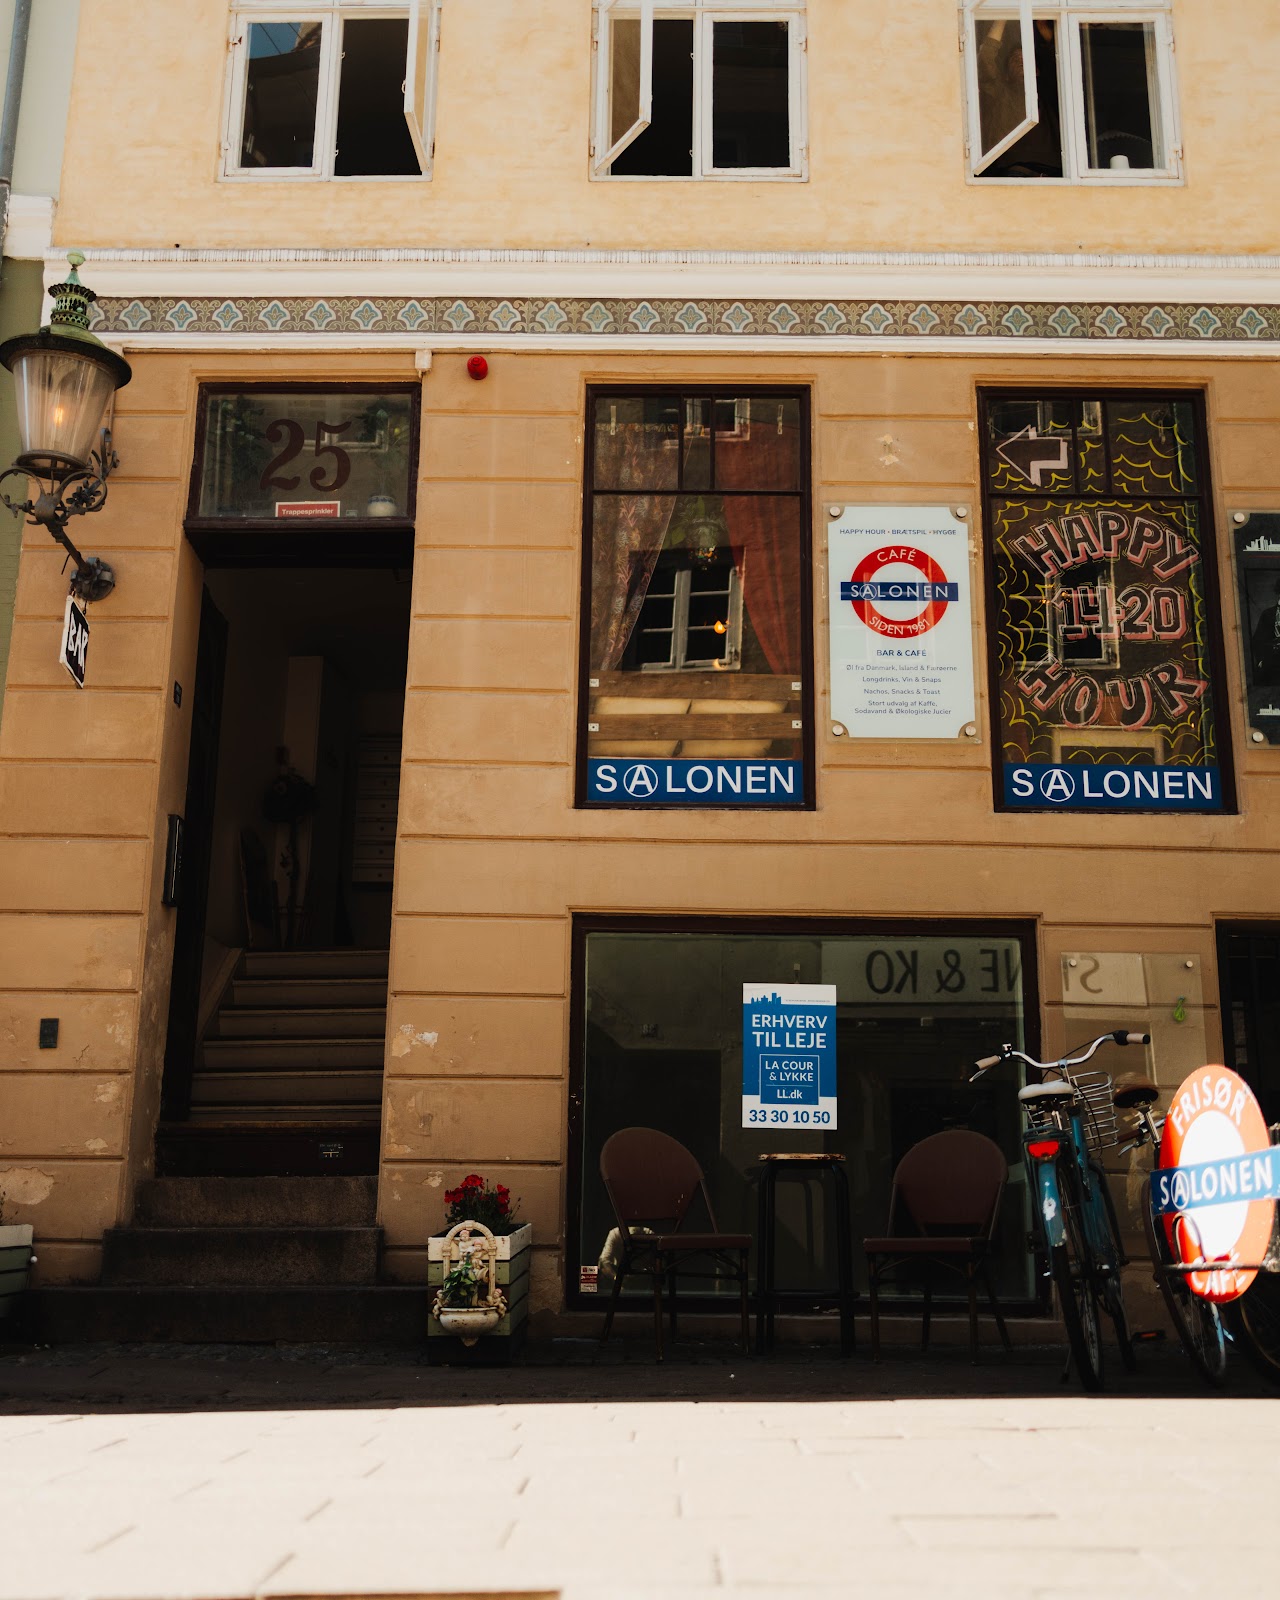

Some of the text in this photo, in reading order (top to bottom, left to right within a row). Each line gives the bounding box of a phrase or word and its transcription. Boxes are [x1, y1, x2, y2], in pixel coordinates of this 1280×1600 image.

[260, 418, 352, 492] 25
[1014, 511, 1199, 579] HAPPY
[877, 548, 917, 562] CAFÉ
[851, 584, 948, 600] SALONEN
[1050, 586, 1188, 640] 14-20
[869, 616, 931, 635] SIDEN 1981
[67, 611, 89, 674] BAR
[904, 648, 927, 656] CAFÉ
[1018, 655, 1208, 731] HOUR
[895, 708, 932, 716] Økologiske
[596, 764, 794, 798] SALONEN
[1012, 768, 1213, 802] SALONEN
[752, 1014, 828, 1029] ERHVERV
[752, 1031, 827, 1049] TIL LEJE
[765, 1060, 814, 1071] LA COUR
[769, 1071, 814, 1082] & LYKKE
[777, 1089, 803, 1099] LL.dk
[1171, 1074, 1247, 1137] FRISØR
[749, 1109, 831, 1124] 33 30 10 50
[1159, 1154, 1274, 1211] SALONEN
